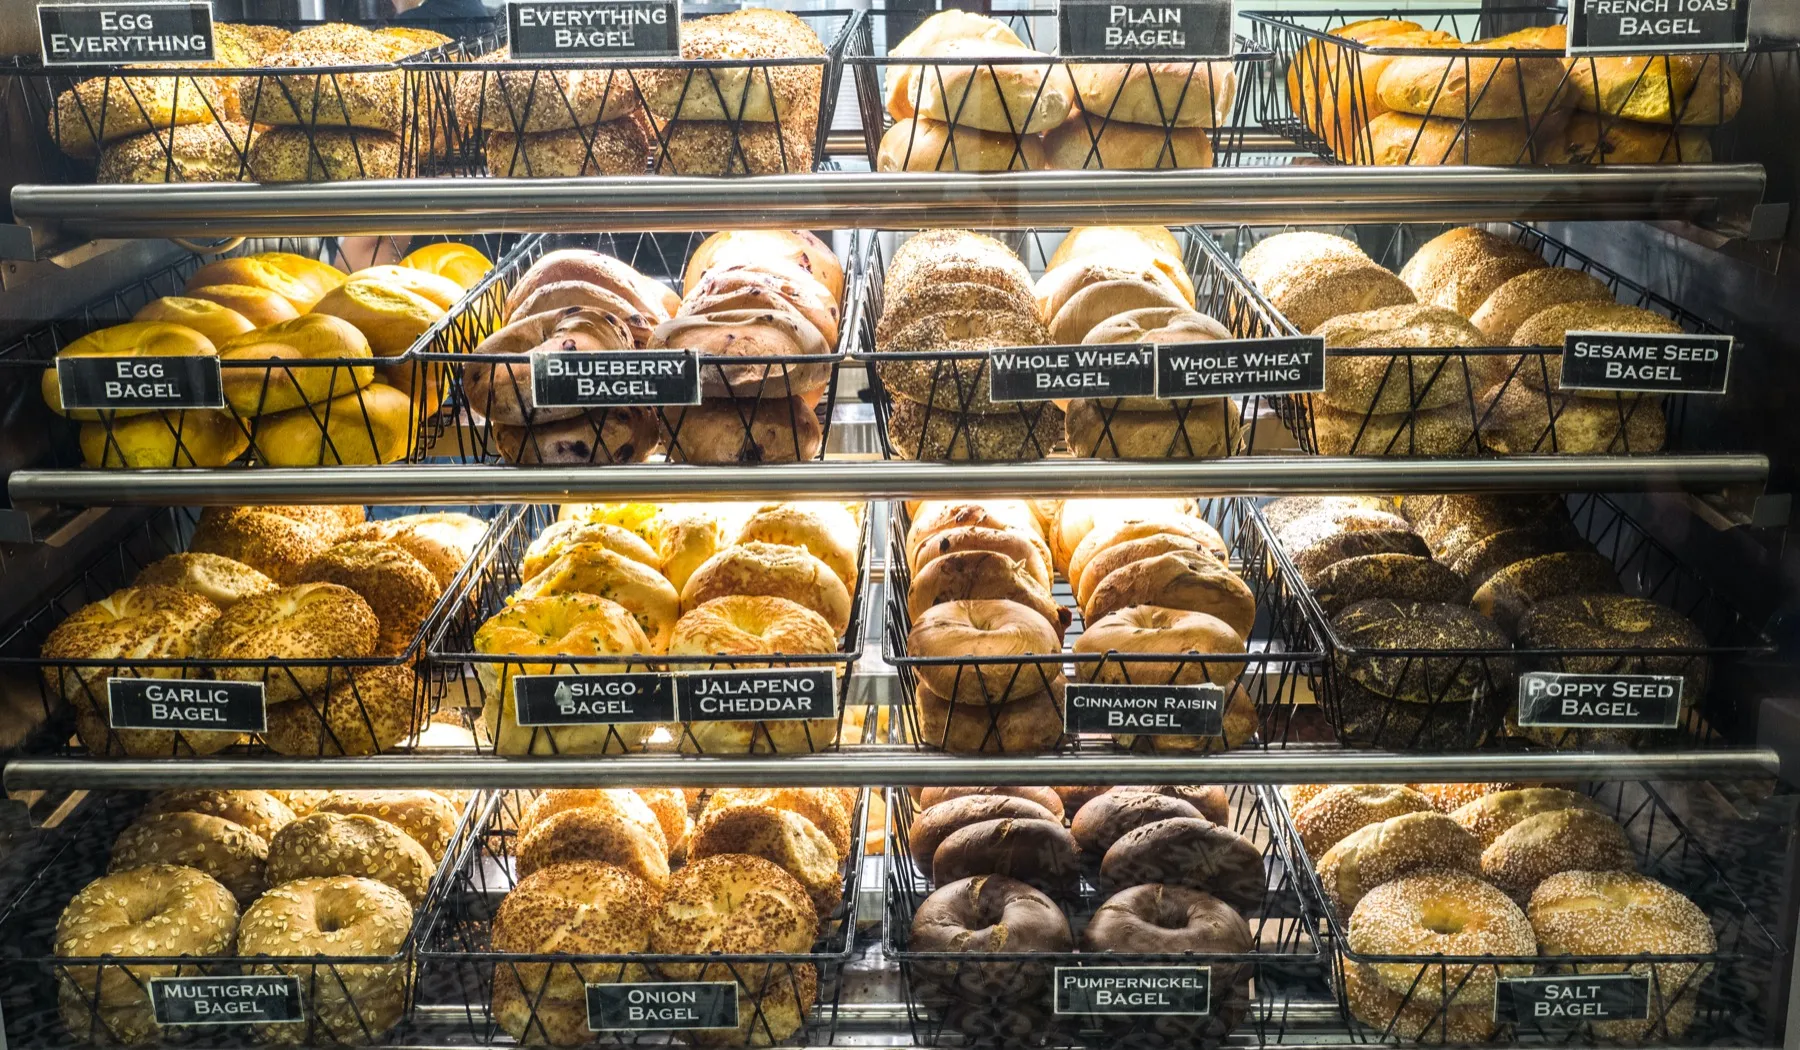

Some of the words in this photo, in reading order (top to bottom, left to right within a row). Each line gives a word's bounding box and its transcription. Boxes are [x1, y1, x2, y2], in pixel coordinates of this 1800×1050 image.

[100, 11, 153, 30] EGG
[519, 8, 667, 27] EVERYTHING
[1110, 5, 1181, 24] PLAIN
[1619, 17, 1701, 36] BAGEL
[51, 33, 207, 53] EVERYTHING
[555, 30, 635, 48] BAGEL
[1105, 27, 1186, 46] BAGEL
[993, 354, 1069, 370] WHOLE
[1074, 350, 1152, 367] WHEAT
[1574, 342, 1658, 360] SESAME
[1663, 345, 1719, 362] SEED
[116, 362, 164, 378] EGG
[547, 360, 686, 378] BLUEBERRY
[1170, 357, 1238, 372] WHOLE
[1242, 352, 1312, 368] WHEAT
[1036, 372, 1110, 389] BAGEL
[1185, 368, 1301, 386] EVERYTHING
[1605, 362, 1682, 381] BAGEL
[105, 382, 181, 398] BAGEL
[577, 378, 658, 397] BAGEL
[146, 685, 230, 703] GARLIC
[695, 678, 815, 697] JALAPENO
[1528, 678, 1606, 697] POPPY
[1612, 682, 1674, 698] SEED
[700, 696, 813, 712] CHEDDAR
[1073, 696, 1158, 710] CINNAMON
[1164, 698, 1217, 710] RAISIN
[1561, 699, 1640, 716] BAGEL
[151, 704, 228, 722] BAGEL
[1107, 711, 1182, 728] BAGEL
[164, 984, 289, 999] MULTIGRAIN
[1063, 976, 1204, 989] PUMPERNICKEL
[628, 990, 697, 1004] ONION
[1096, 990, 1171, 1006] BAGEL
[1545, 984, 1601, 1000] SALT
[194, 1000, 265, 1015] BAGEL
[628, 1006, 700, 1021] BAGEL
[1535, 1001, 1609, 1017] BAGEL
